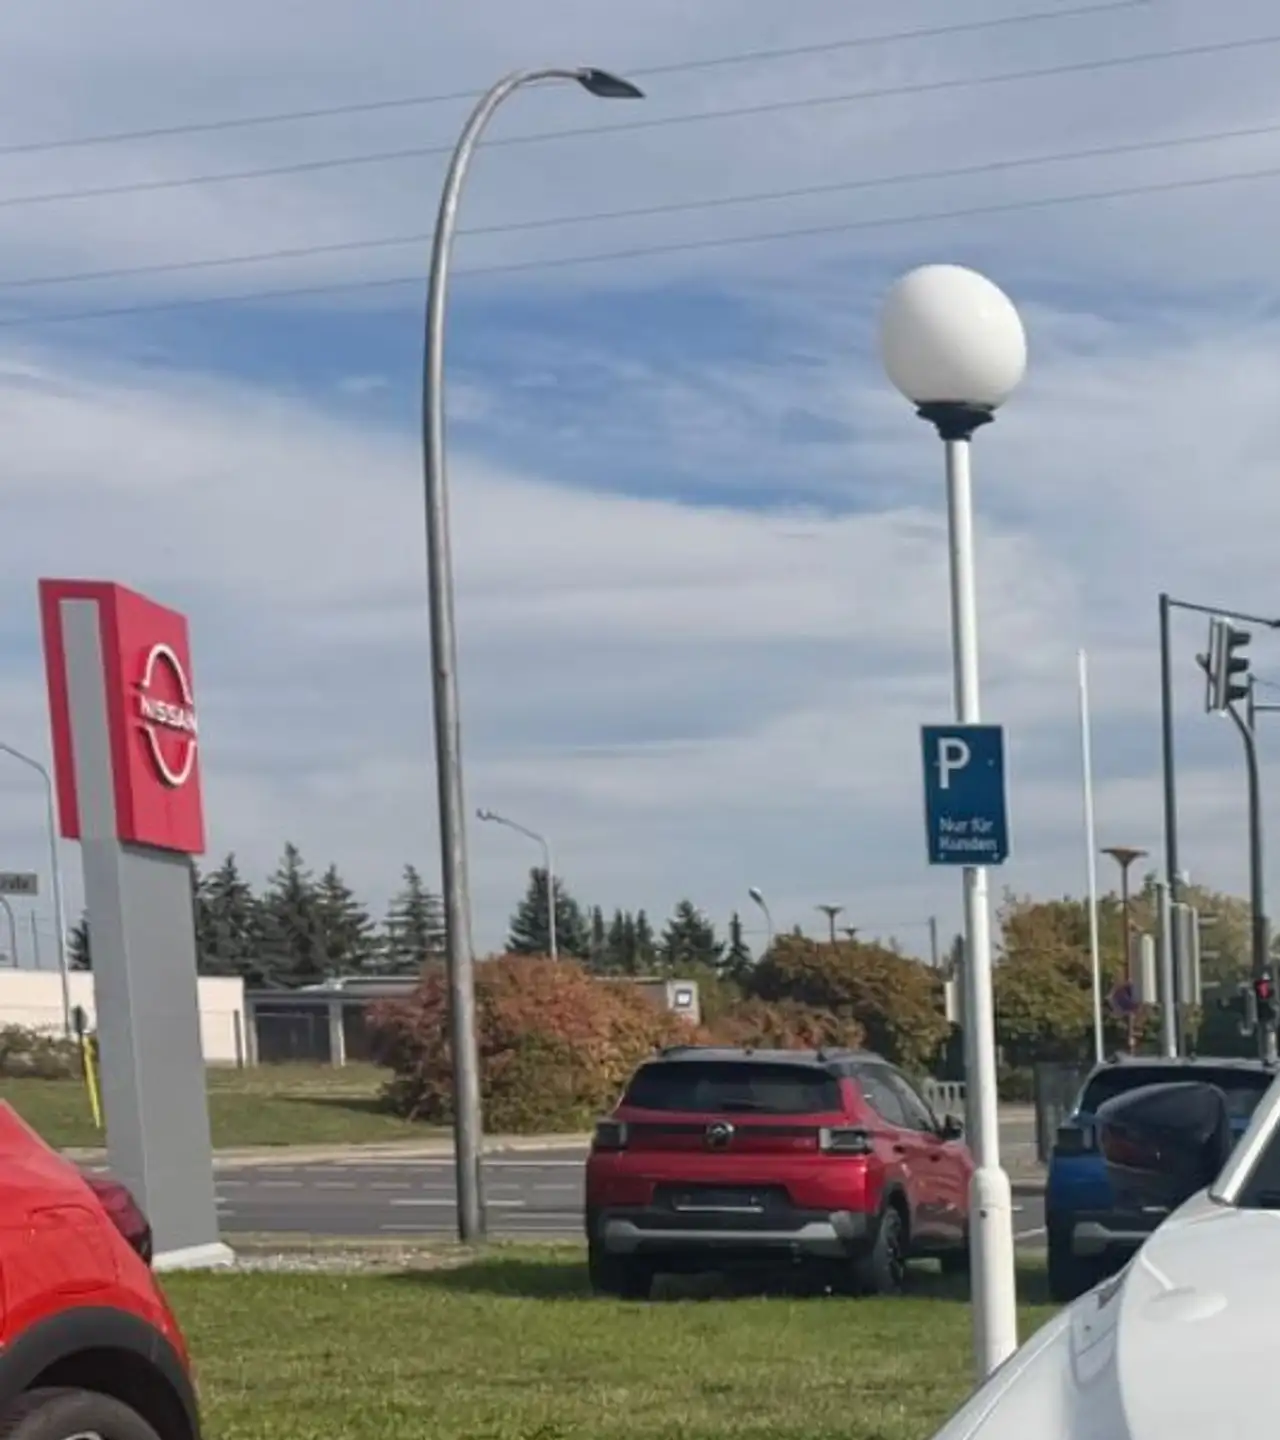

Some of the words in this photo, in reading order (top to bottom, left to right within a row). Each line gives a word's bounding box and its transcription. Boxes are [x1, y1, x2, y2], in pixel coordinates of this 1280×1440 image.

[141, 694, 197, 732] NISSAN
[939, 737, 971, 789] P
[940, 816, 968, 832] Nur
[971, 817, 993, 832] für
[940, 836, 997, 850] Kunden
